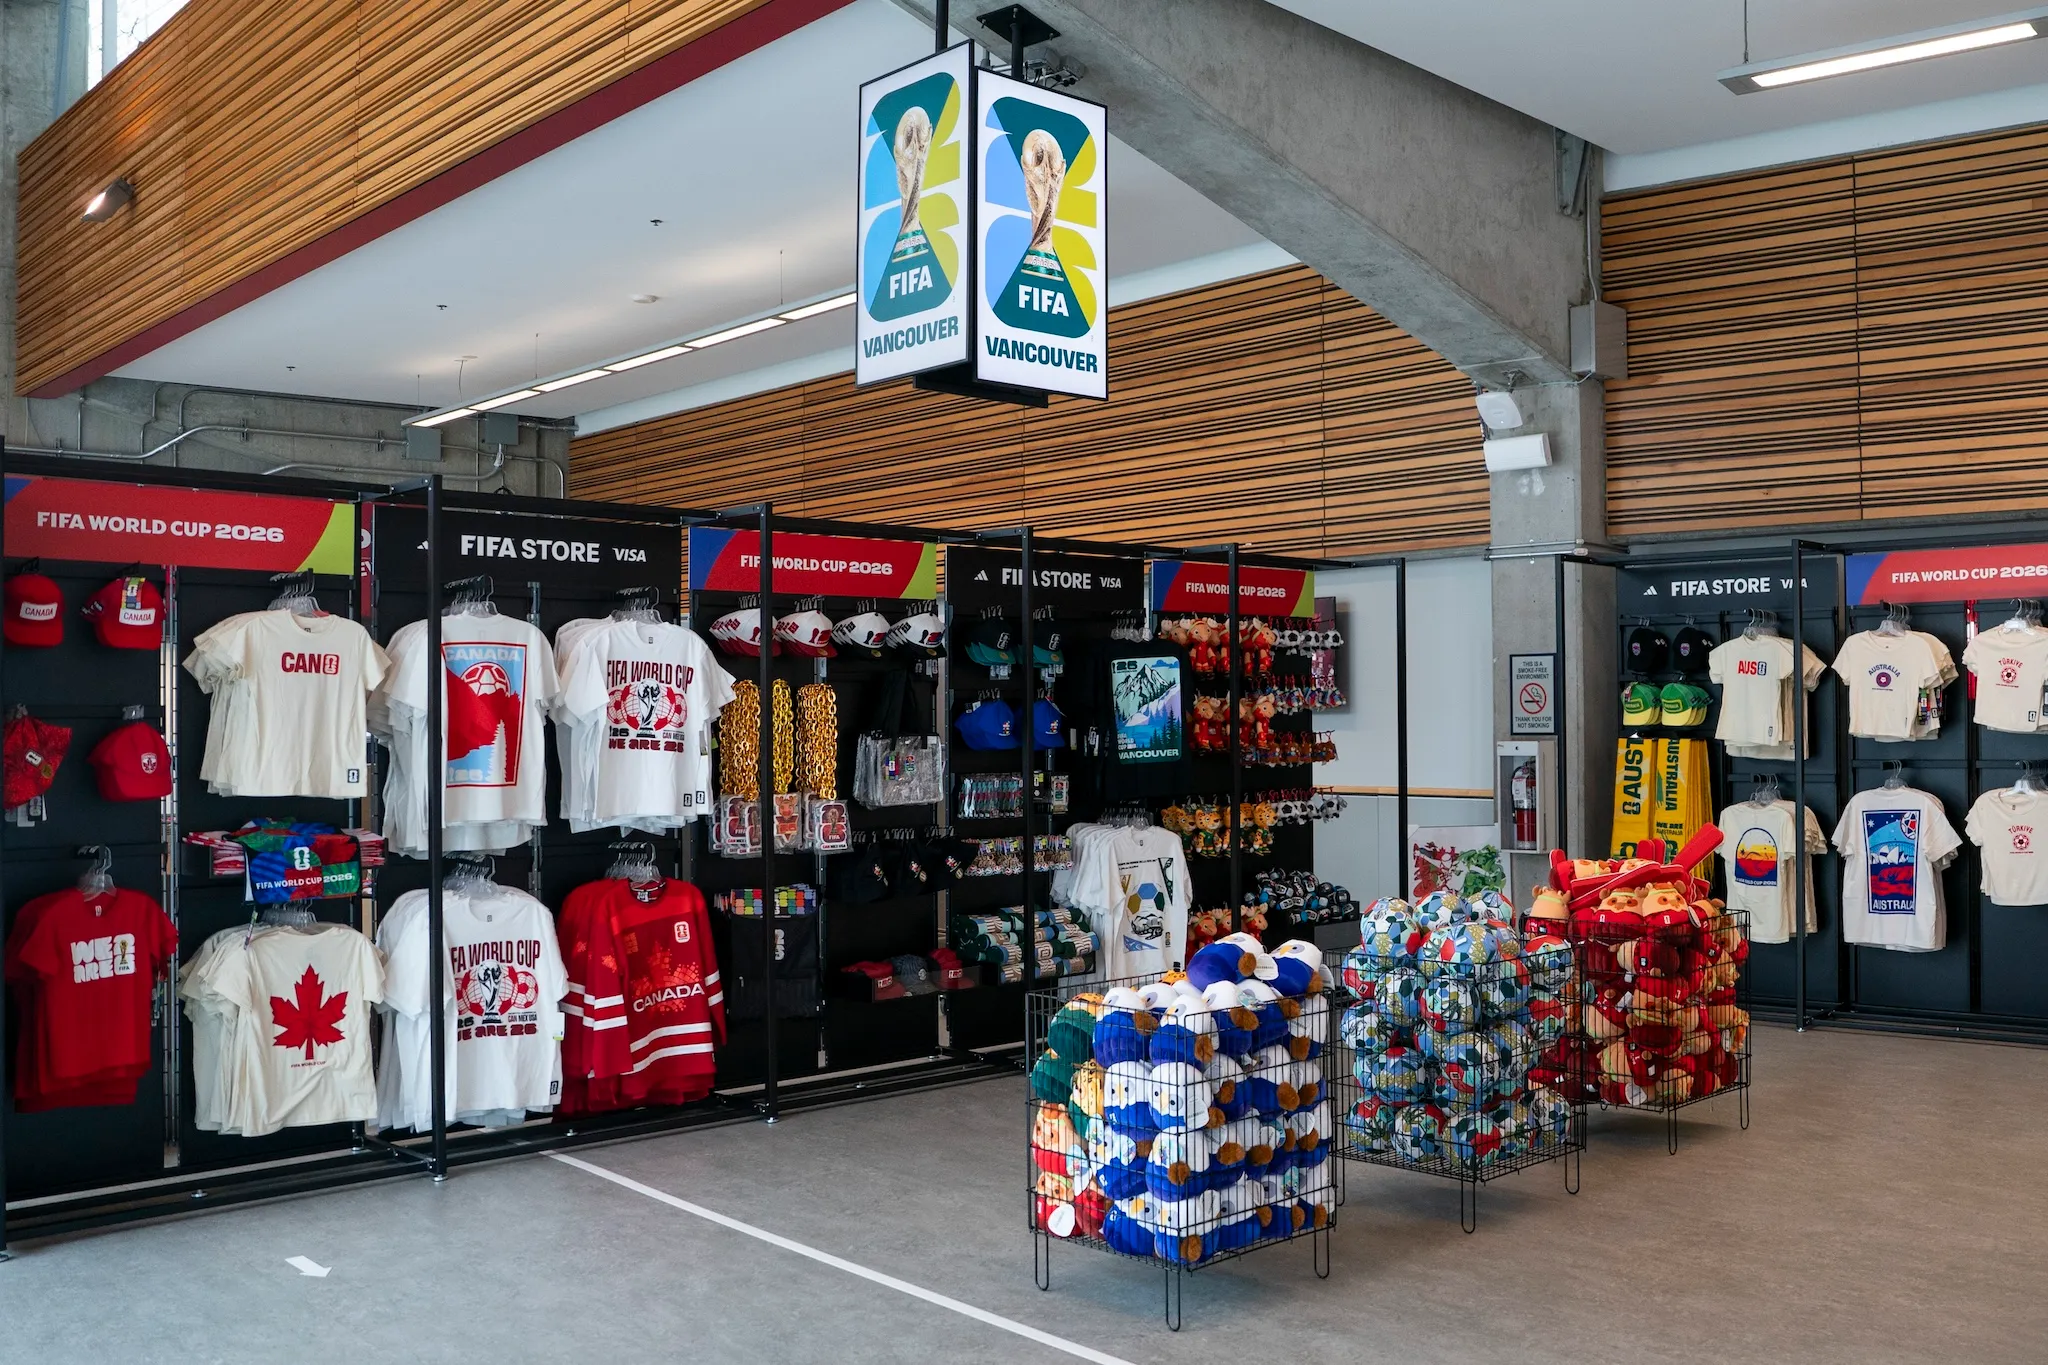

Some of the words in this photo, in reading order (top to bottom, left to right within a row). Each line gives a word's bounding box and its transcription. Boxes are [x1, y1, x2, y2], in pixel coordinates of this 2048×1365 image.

[889, 264, 933, 299] FIFA
[1018, 284, 1070, 317] FIFA
[863, 315, 959, 358] VANCOUVER
[985, 335, 1098, 373] VANCOUVER
[37, 511, 85, 530] FIFA
[88, 514, 167, 535] WORLD
[170, 520, 212, 537] CUP
[215, 523, 285, 543] 2026
[460, 534, 517, 559] FIFA
[521, 538, 600, 563] STORE
[612, 547, 647, 562] VISA
[740, 554, 761, 568] FIF
[772, 556, 820, 571] WORLD
[821, 559, 848, 573] CUP
[849, 561, 893, 576] 2026
[1891, 571, 1920, 584] FIFA
[1921, 569, 1969, 582] WORLD
[1971, 567, 1998, 580] CUP
[2000, 564, 2048, 578] 2026
[1040, 570, 1092, 590] STORE
[1099, 576, 1122, 588] VISA
[1186, 582, 1205, 593] FIFA
[1238, 585, 1256, 596] CUP
[1257, 587, 1286, 598] 2026
[1671, 580, 1710, 597] FIFA
[1712, 576, 1771, 595] STORE
[1780, 578, 1808, 589] VIA
[24, 607, 54, 617] CANADA
[123, 612, 152, 621] CANADA
[281, 652, 322, 673] CAN
[445, 647, 521, 661] CANADA
[606, 660, 628, 690] FIFA
[631, 661, 673, 685] WORLD
[1738, 660, 1758, 675] AUS
[1868, 663, 1901, 678] AUSTRALIA
[628, 738, 661, 751] ARE
[1118, 748, 1179, 760] VANCOUVER
[256, 881, 274, 890] FIFA
[275, 878, 305, 889] WORLD
[306, 876, 322, 885] CUP
[323, 872, 353, 884] 2026
[70, 936, 113, 965] WE
[469, 940, 513, 967] WORLD
[516, 939, 541, 970] CUP
[73, 960, 114, 984] ARE
[633, 982, 705, 1013] CANADA
[475, 1025, 508, 1038] ARE
